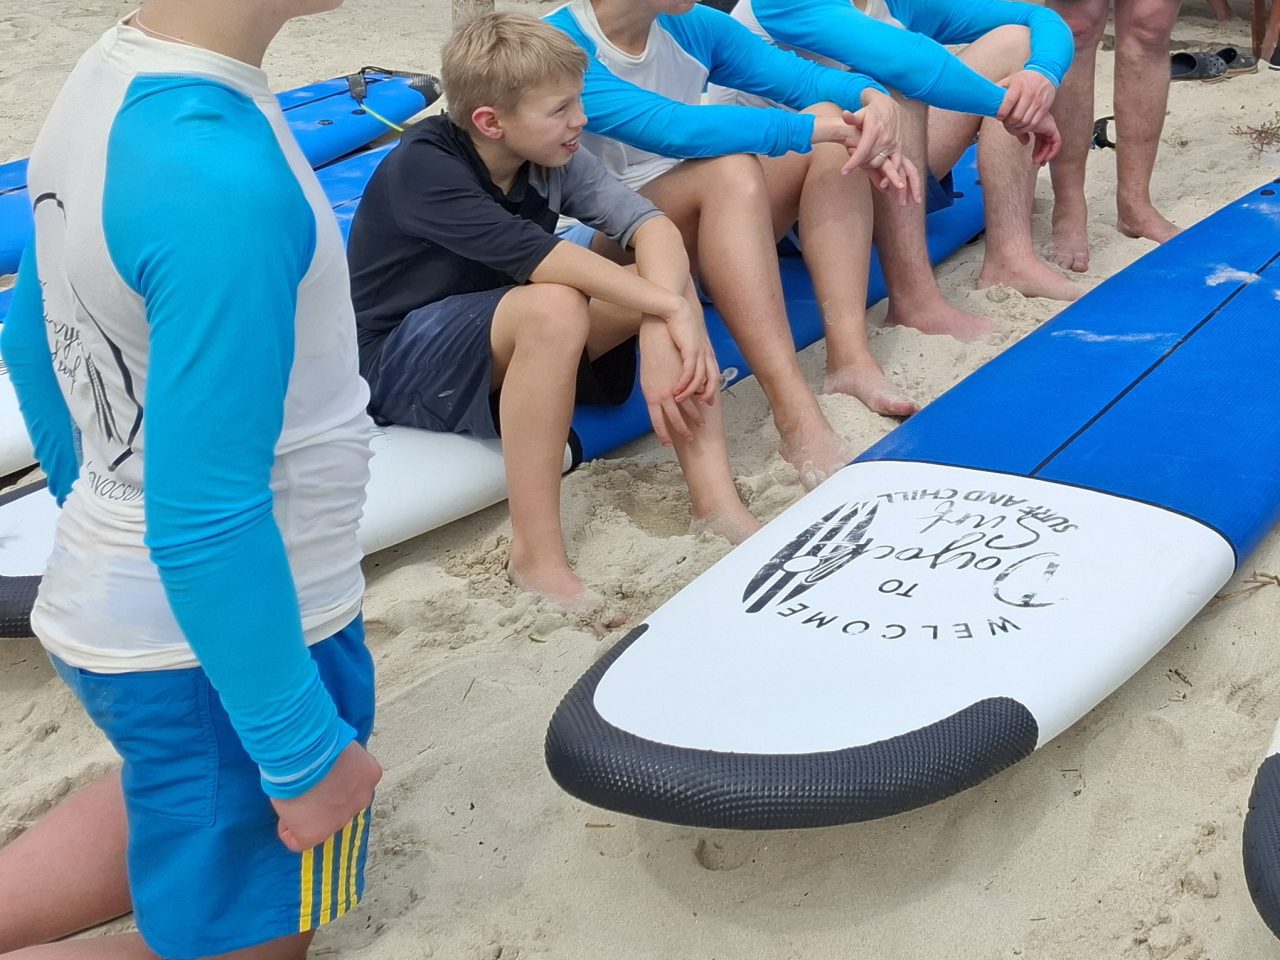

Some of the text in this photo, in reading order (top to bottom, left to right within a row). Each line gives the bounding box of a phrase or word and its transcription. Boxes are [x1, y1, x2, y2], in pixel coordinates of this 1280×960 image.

[877, 488, 1079, 534] SURF AND CHILL
[916, 500, 1041, 550] Surf
[878, 578, 919, 598] TO
[776, 602, 1022, 640] WELCOME
